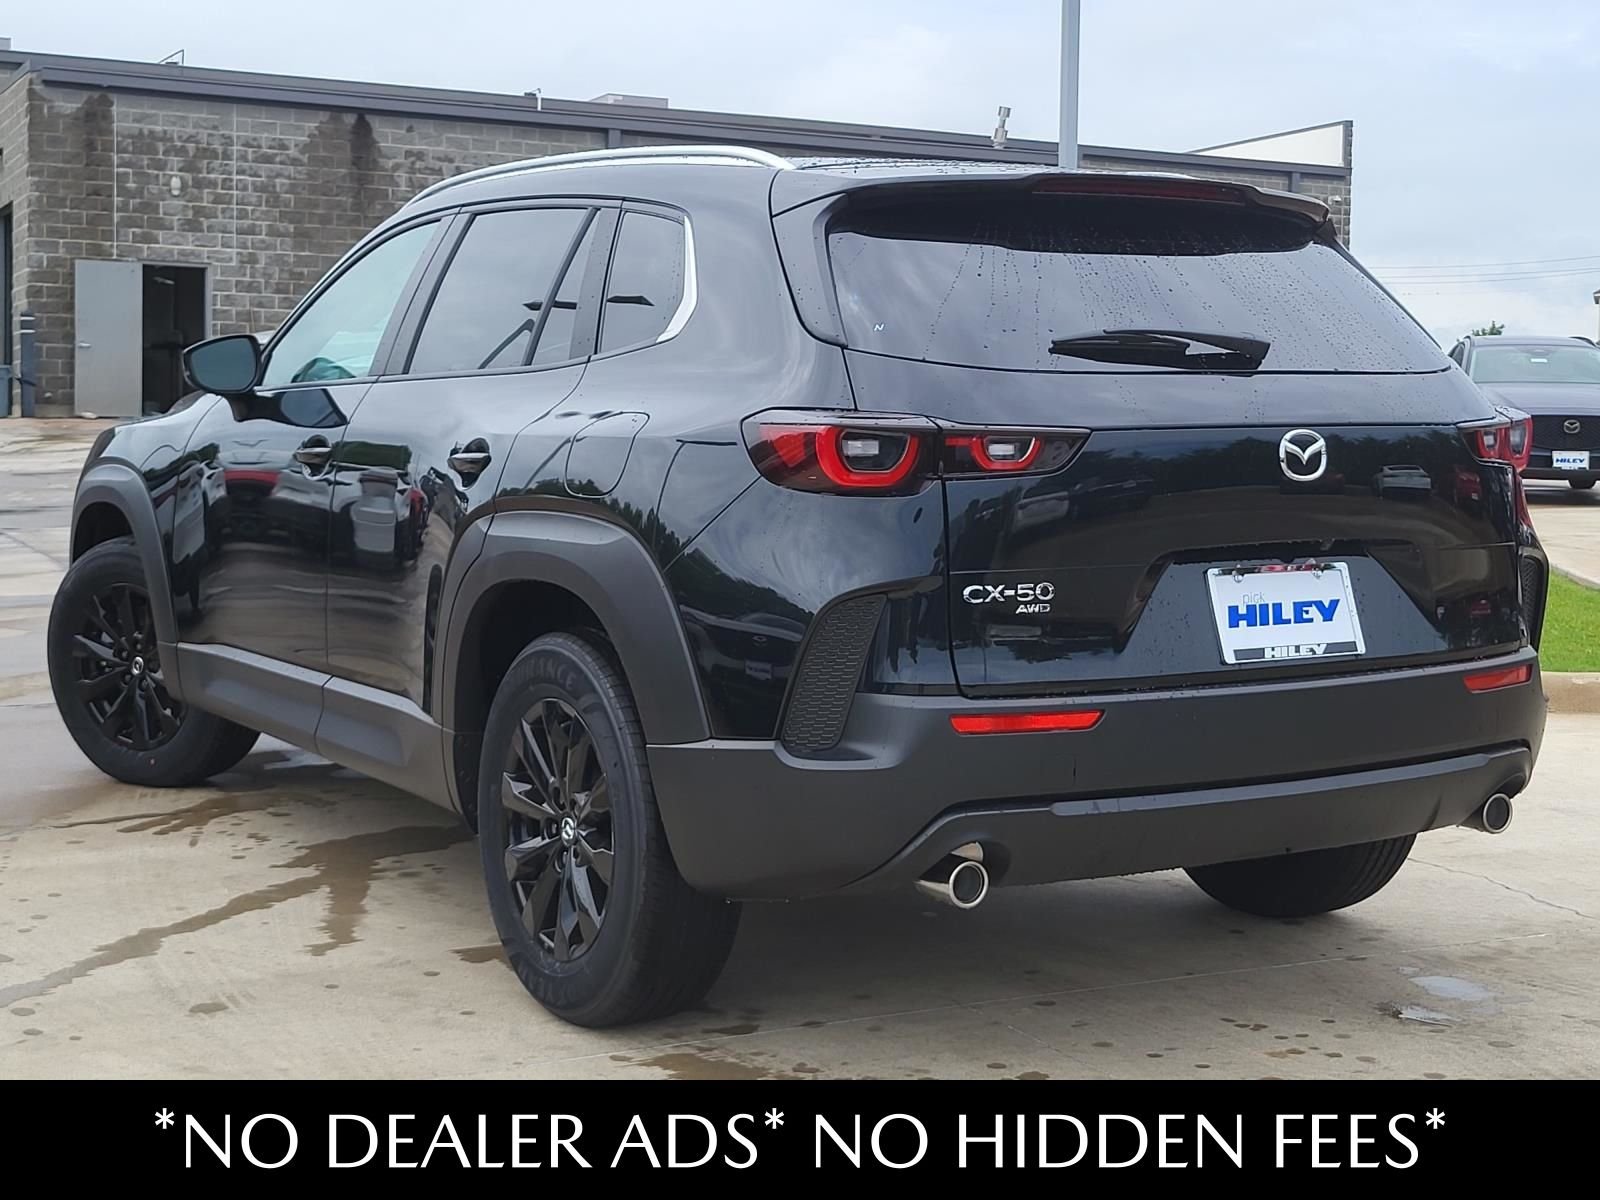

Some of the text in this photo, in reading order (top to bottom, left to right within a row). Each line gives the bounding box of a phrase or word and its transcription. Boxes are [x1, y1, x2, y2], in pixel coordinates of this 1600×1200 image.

[962, 582, 1055, 604] CX-50
[1015, 603, 1051, 614] AWD
[1228, 598, 1341, 628] HILEY
[1264, 643, 1328, 659] HILEY
